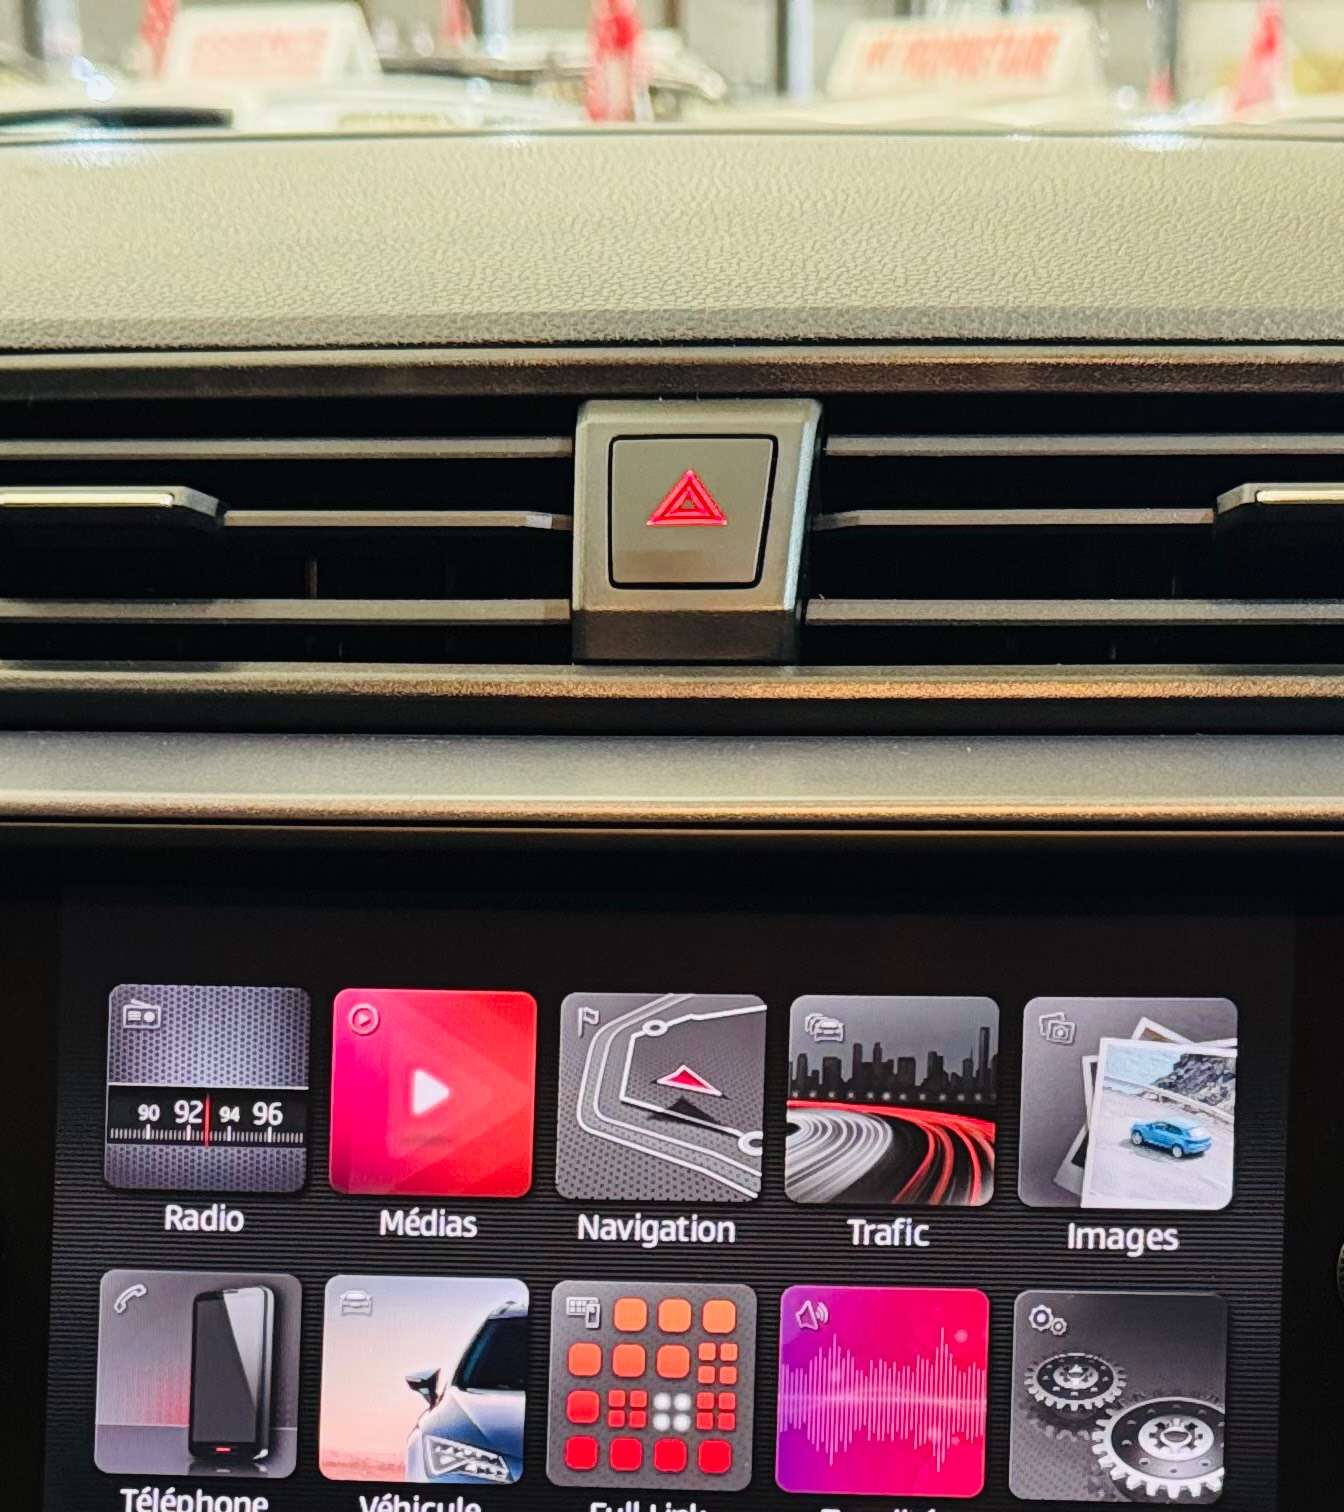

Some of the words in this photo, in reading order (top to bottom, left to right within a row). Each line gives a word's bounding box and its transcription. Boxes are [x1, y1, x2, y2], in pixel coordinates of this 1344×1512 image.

[137, 1104, 161, 1122] 90
[174, 1100, 204, 1124] 92
[219, 1106, 241, 1123] 94
[253, 1101, 284, 1126] 96
[164, 1203, 245, 1232] Radio
[379, 1206, 478, 1238] Médias
[577, 1212, 736, 1249] Navigation
[847, 1217, 930, 1247] Trafic
[1067, 1222, 1180, 1258] Images
